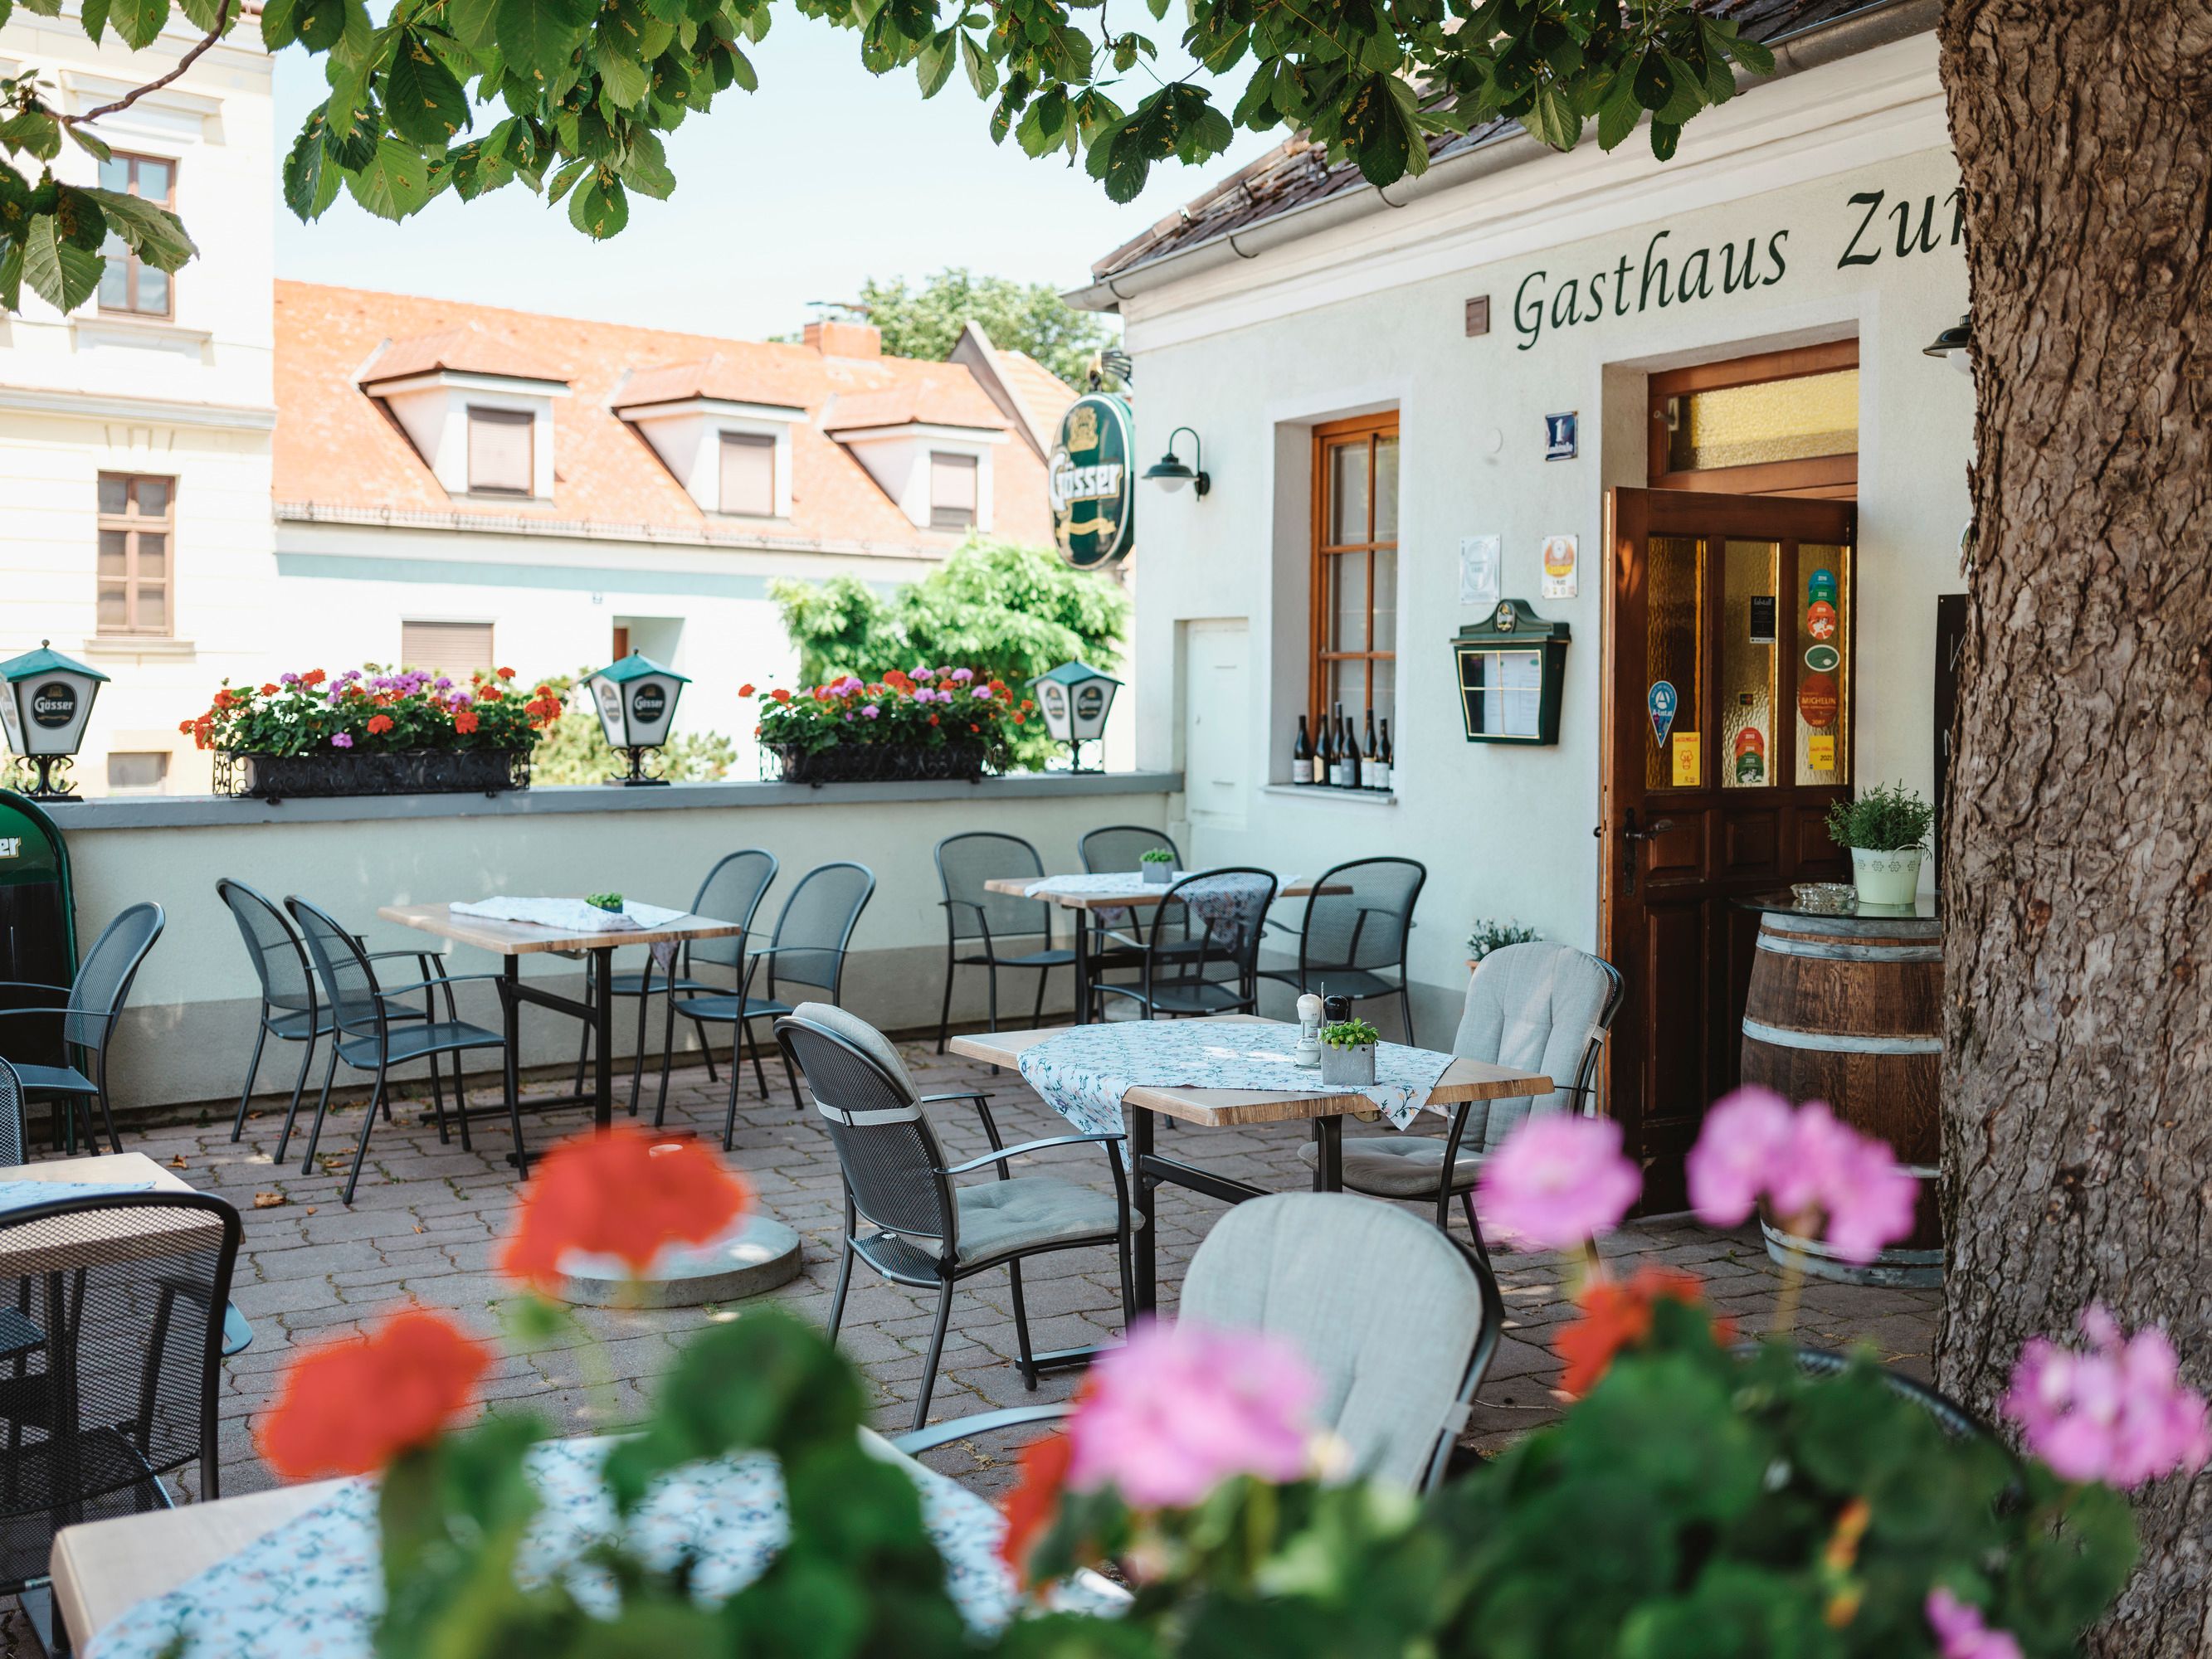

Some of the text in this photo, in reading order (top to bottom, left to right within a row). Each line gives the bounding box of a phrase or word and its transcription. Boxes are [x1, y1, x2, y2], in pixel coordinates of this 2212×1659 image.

[1514, 230, 1789, 351] Gasthaus
[1555, 418, 1563, 442] 1
[1050, 452, 1123, 512] Gösser
[34, 696, 74, 713] Gösser
